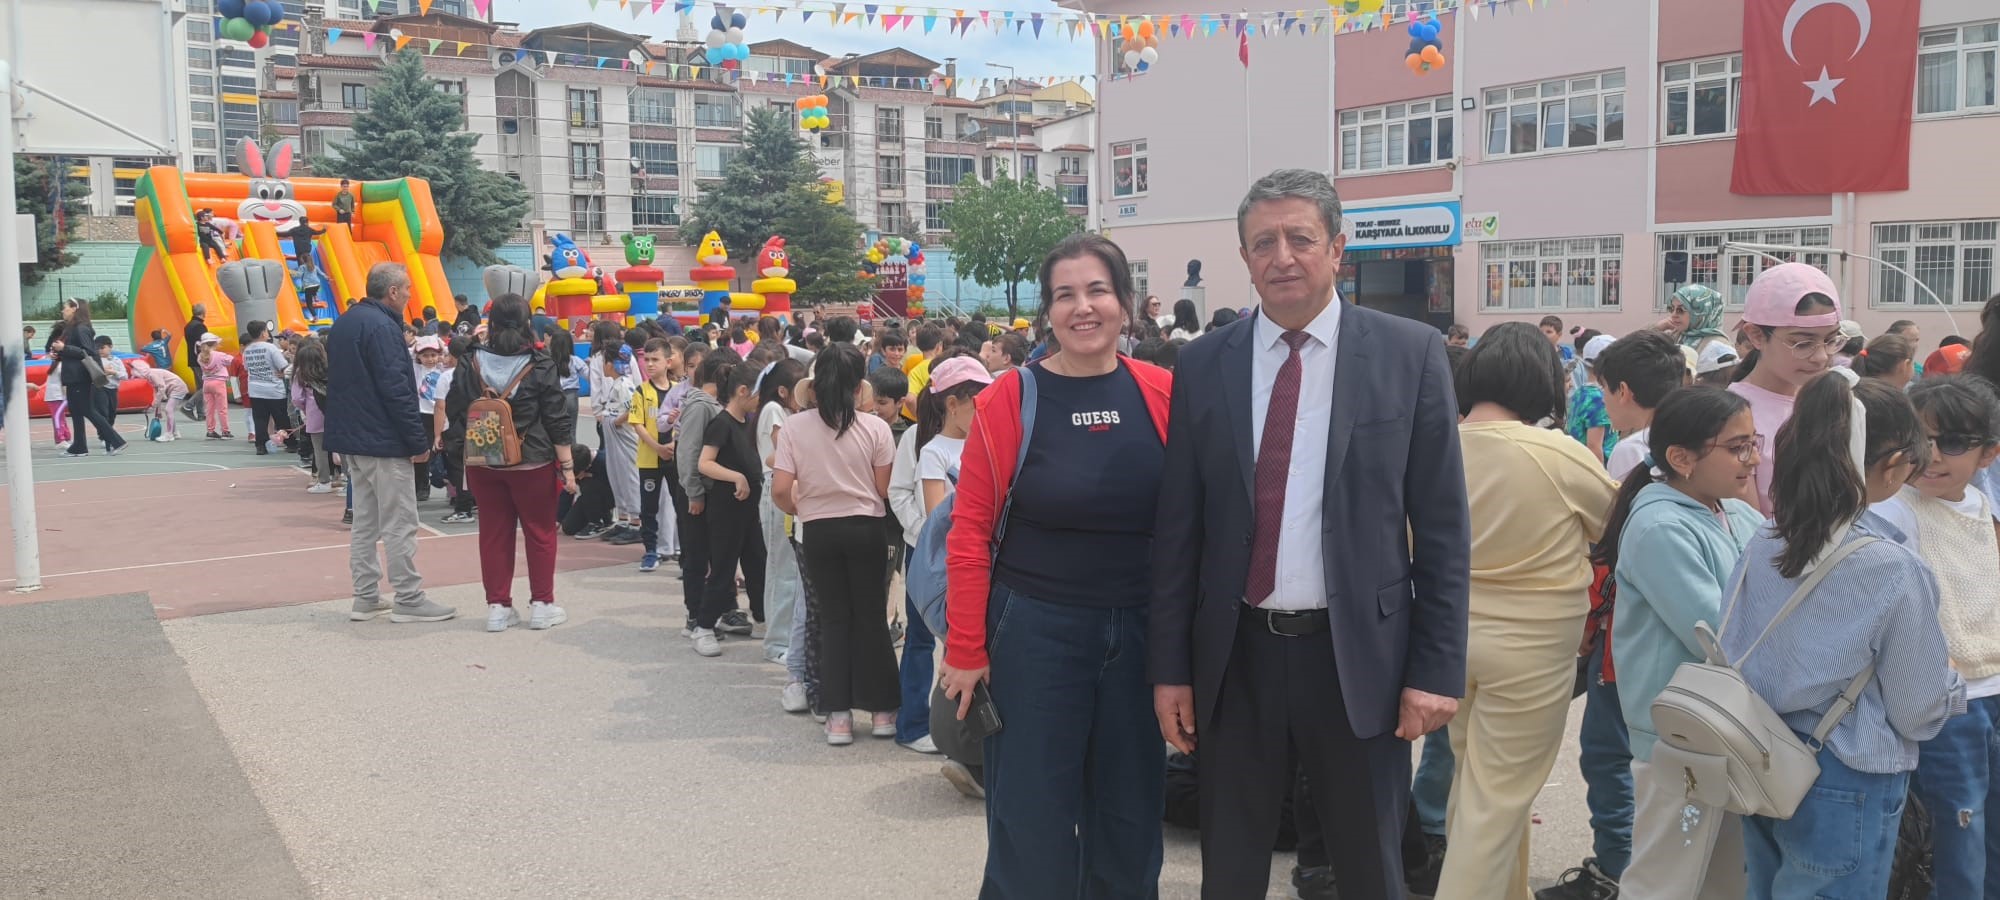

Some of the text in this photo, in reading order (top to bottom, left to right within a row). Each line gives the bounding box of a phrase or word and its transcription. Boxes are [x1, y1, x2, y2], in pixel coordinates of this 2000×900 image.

[1377, 219, 1401, 227] MERKEZ
[1355, 227, 1404, 240] KARŞIYAKA
[1405, 224, 1450, 236] İLKOKULU
[659, 288, 704, 298] ANGRY BIRDS
[1072, 410, 1121, 426] GUESS
